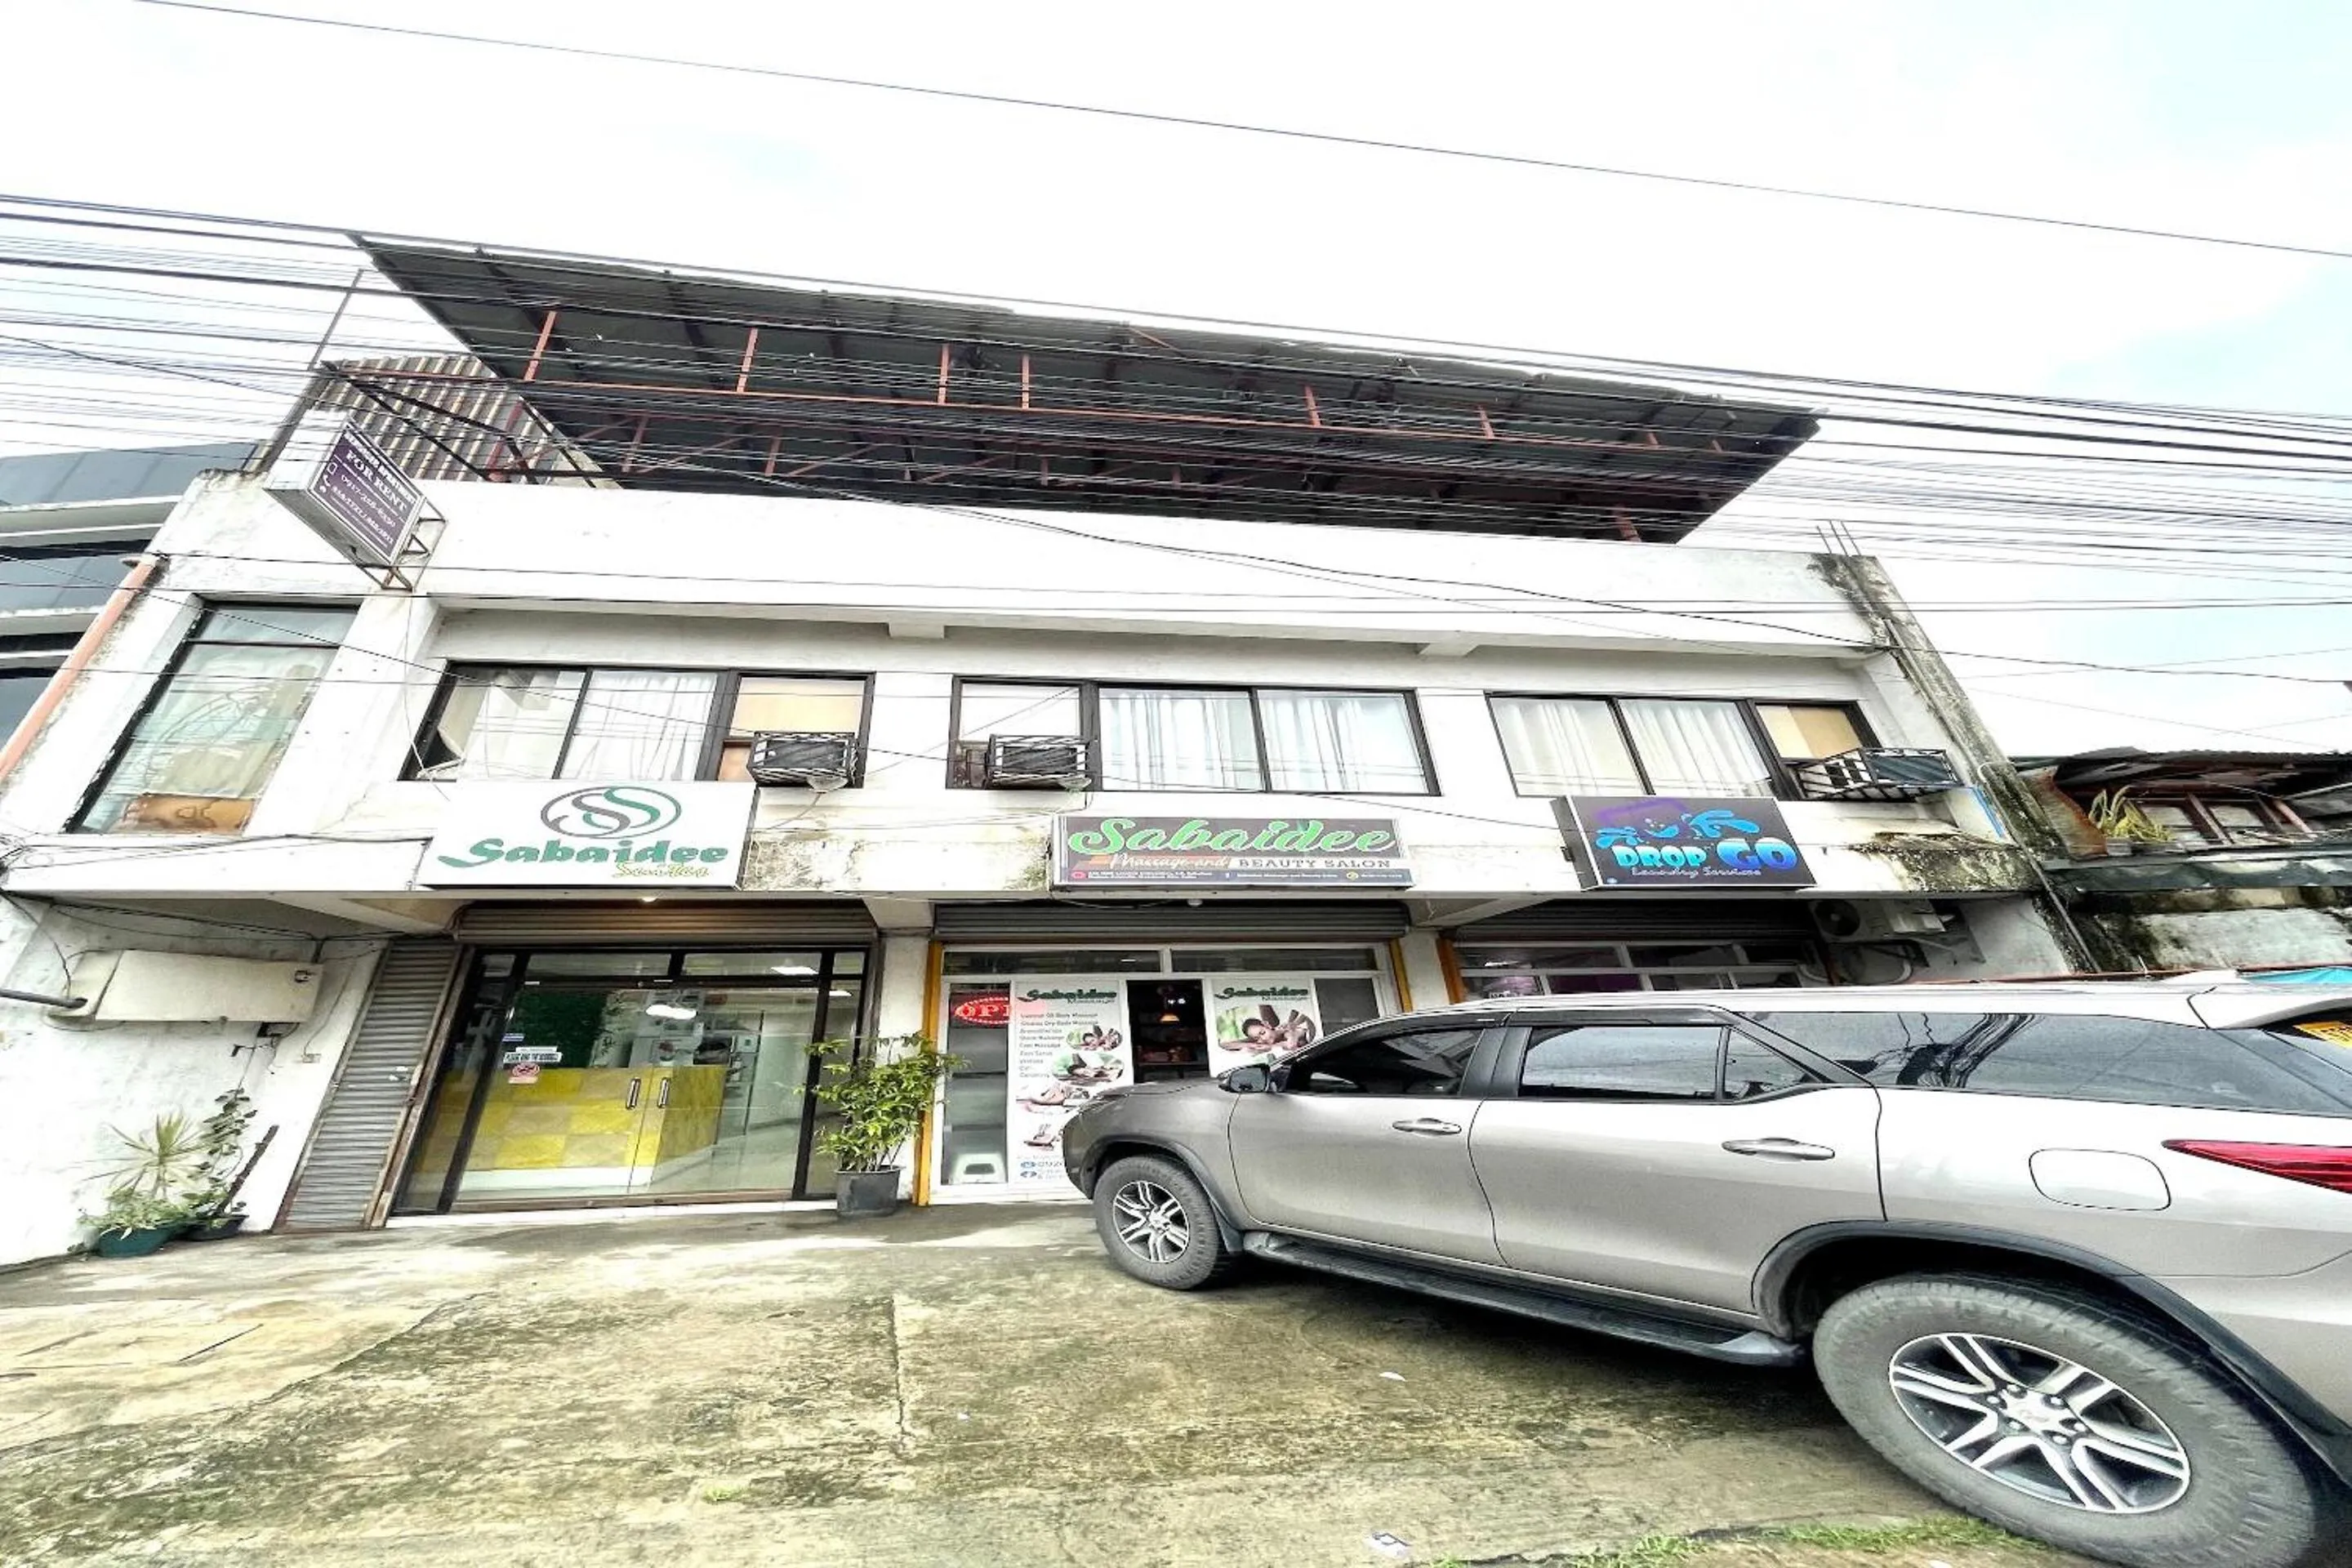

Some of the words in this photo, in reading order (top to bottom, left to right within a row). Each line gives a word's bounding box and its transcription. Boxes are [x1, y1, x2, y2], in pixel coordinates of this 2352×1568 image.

[346, 450, 373, 482] FOR
[374, 476, 408, 511] RENT
[1067, 818, 1396, 854] Sabaidee
[438, 838, 728, 868] Sabaidee
[1240, 859, 1316, 868] BEAUTY
[1325, 859, 1390, 868] SALON
[1611, 845, 1707, 867] DROP
[1717, 837, 1797, 870] GO
